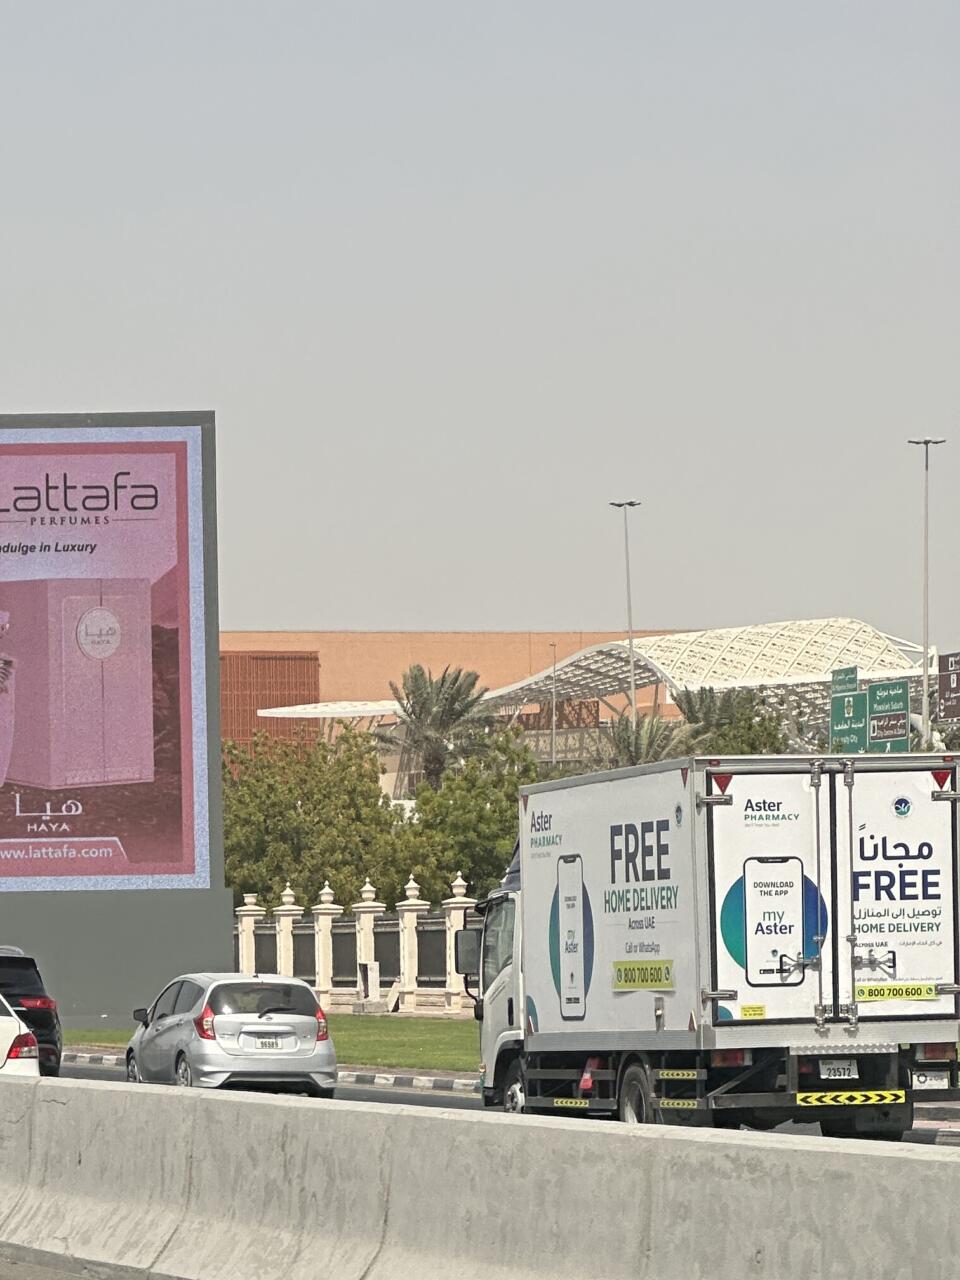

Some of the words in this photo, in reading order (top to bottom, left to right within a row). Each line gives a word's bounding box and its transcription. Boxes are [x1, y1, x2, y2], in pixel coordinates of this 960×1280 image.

[30, 516, 110, 526] PERFUMES
[39, 542, 51, 553] in
[54, 542, 97, 554] Luxury
[744, 799, 783, 812] Aster
[530, 810, 552, 833] Aster
[744, 813, 800, 821] PHARMACY
[27, 823, 70, 833] HAYA
[530, 834, 562, 848] PHARMACY
[610, 819, 671, 884] FREE
[753, 881, 794, 889] DOWNLOAD
[852, 869, 941, 901] FREE
[604, 888, 631, 913] HOME
[633, 885, 679, 912] DELIVERY
[762, 910, 785, 924] my
[854, 908, 890, 920] المنازل
[891, 908, 905, 919] إلى
[907, 906, 942, 919] توصيل
[644, 916, 656, 929] UAE
[754, 922, 794, 935] Aster
[854, 923, 885, 933] HOME
[888, 922, 941, 932] DELIVERY
[623, 967, 636, 983] 800
[637, 967, 649, 983] 700
[650, 967, 662, 983] 600
[868, 988, 885, 997] 800
[887, 988, 903, 996] 700
[905, 987, 922, 996] 600
[827, 1067, 851, 1078] 23572
